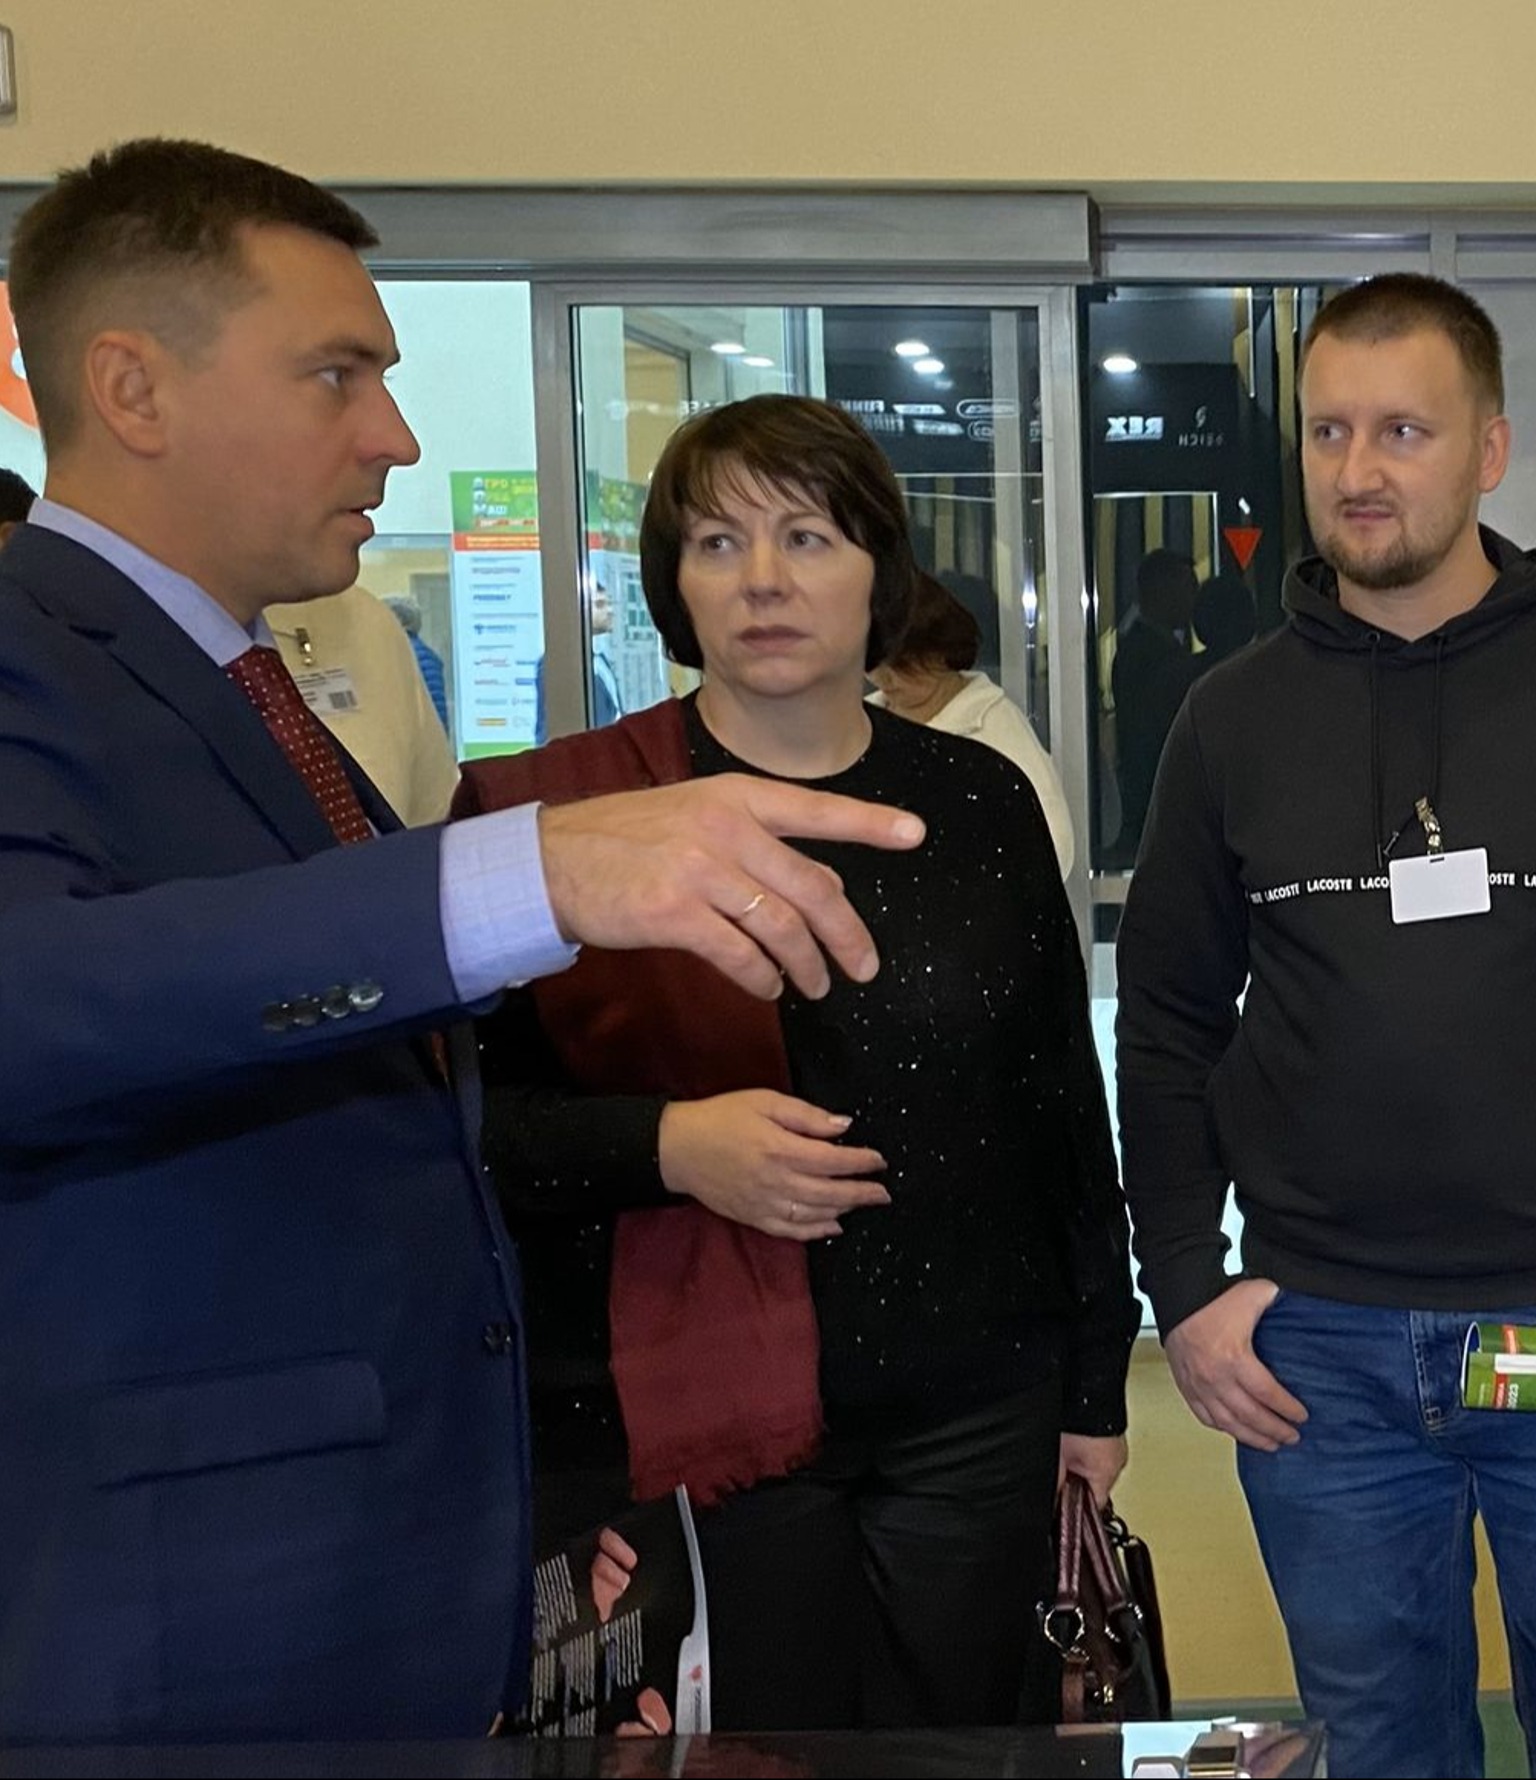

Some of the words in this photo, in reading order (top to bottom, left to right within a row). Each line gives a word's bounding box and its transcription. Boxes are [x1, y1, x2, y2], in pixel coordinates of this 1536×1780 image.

[1306, 878, 1352, 893] LACOSTE
[1360, 876, 1389, 890] LACO
[1489, 872, 1516, 886] OSTE
